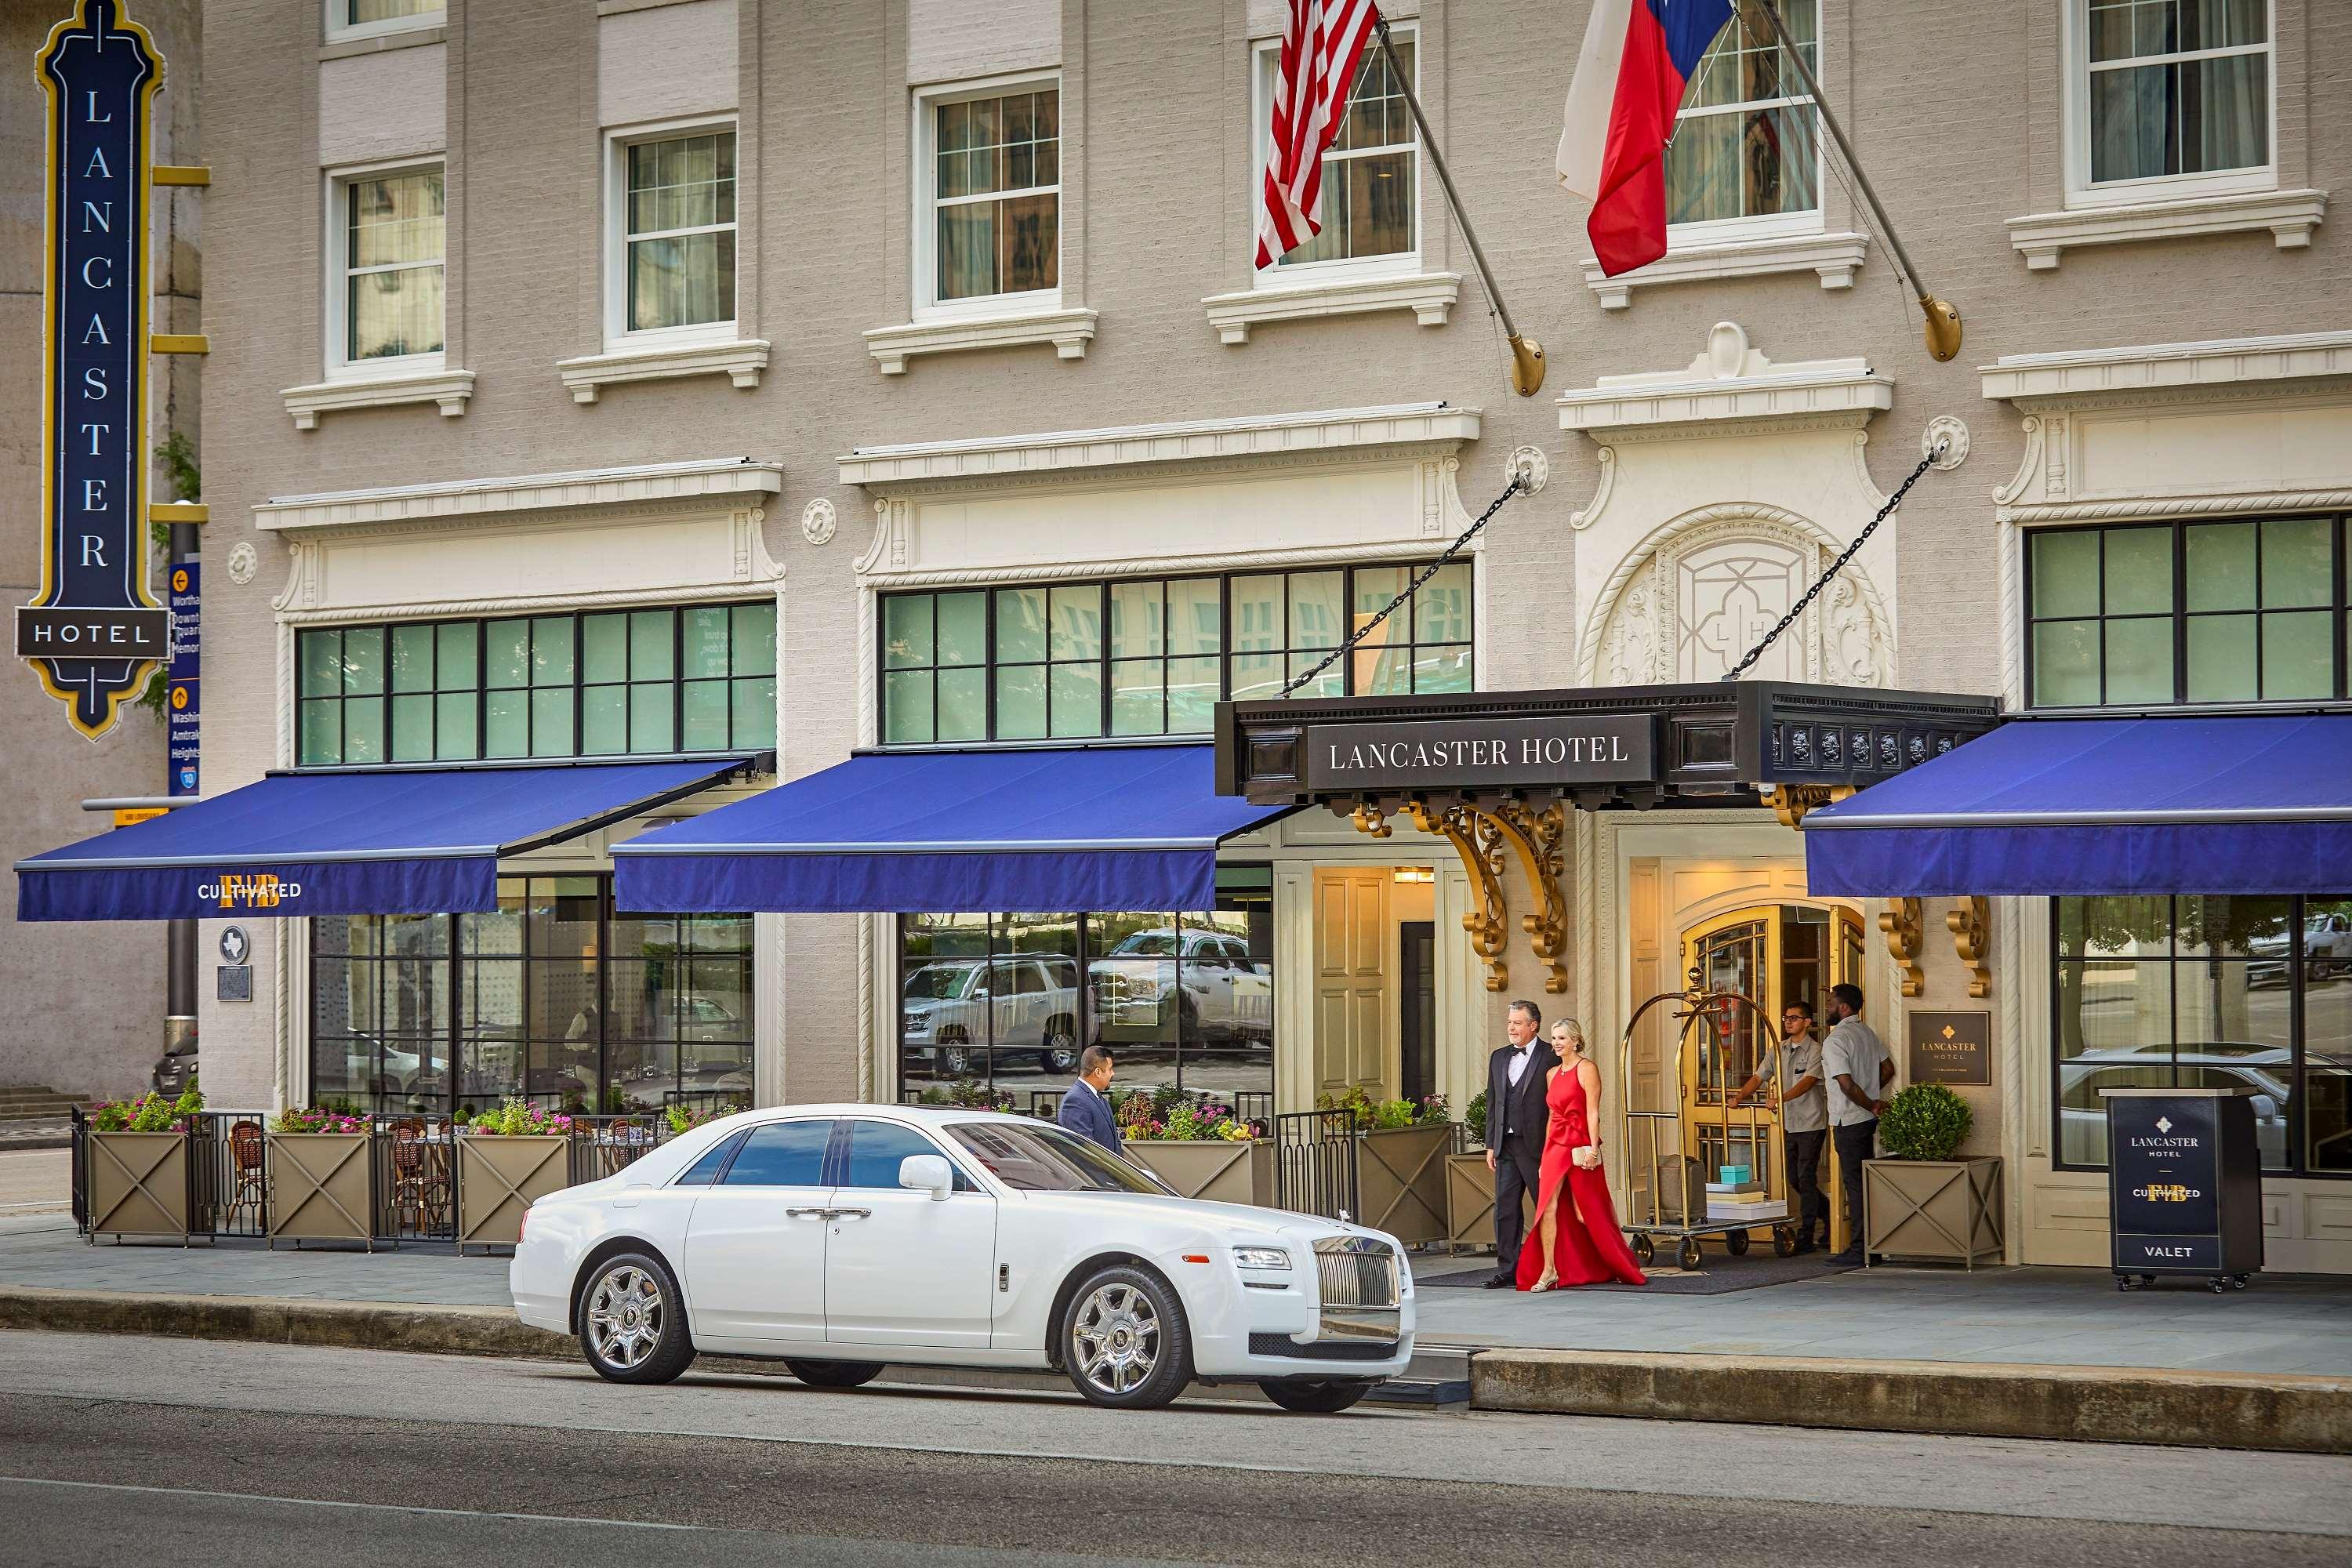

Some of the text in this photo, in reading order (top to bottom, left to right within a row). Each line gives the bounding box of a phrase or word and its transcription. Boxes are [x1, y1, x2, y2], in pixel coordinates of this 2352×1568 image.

[81, 91, 113, 567] LANCASTER
[35, 625, 150, 643] HOTEL
[1330, 735, 1628, 770] LANCASTER HOTEL
[198, 883, 301, 899] CULTIVATED
[1922, 1043, 1976, 1051] LANCASTER
[2132, 1138, 2198, 1147] LANCASTER
[2132, 1189, 2201, 1197] CULTIVATED
[2144, 1247, 2193, 1257] VALET
